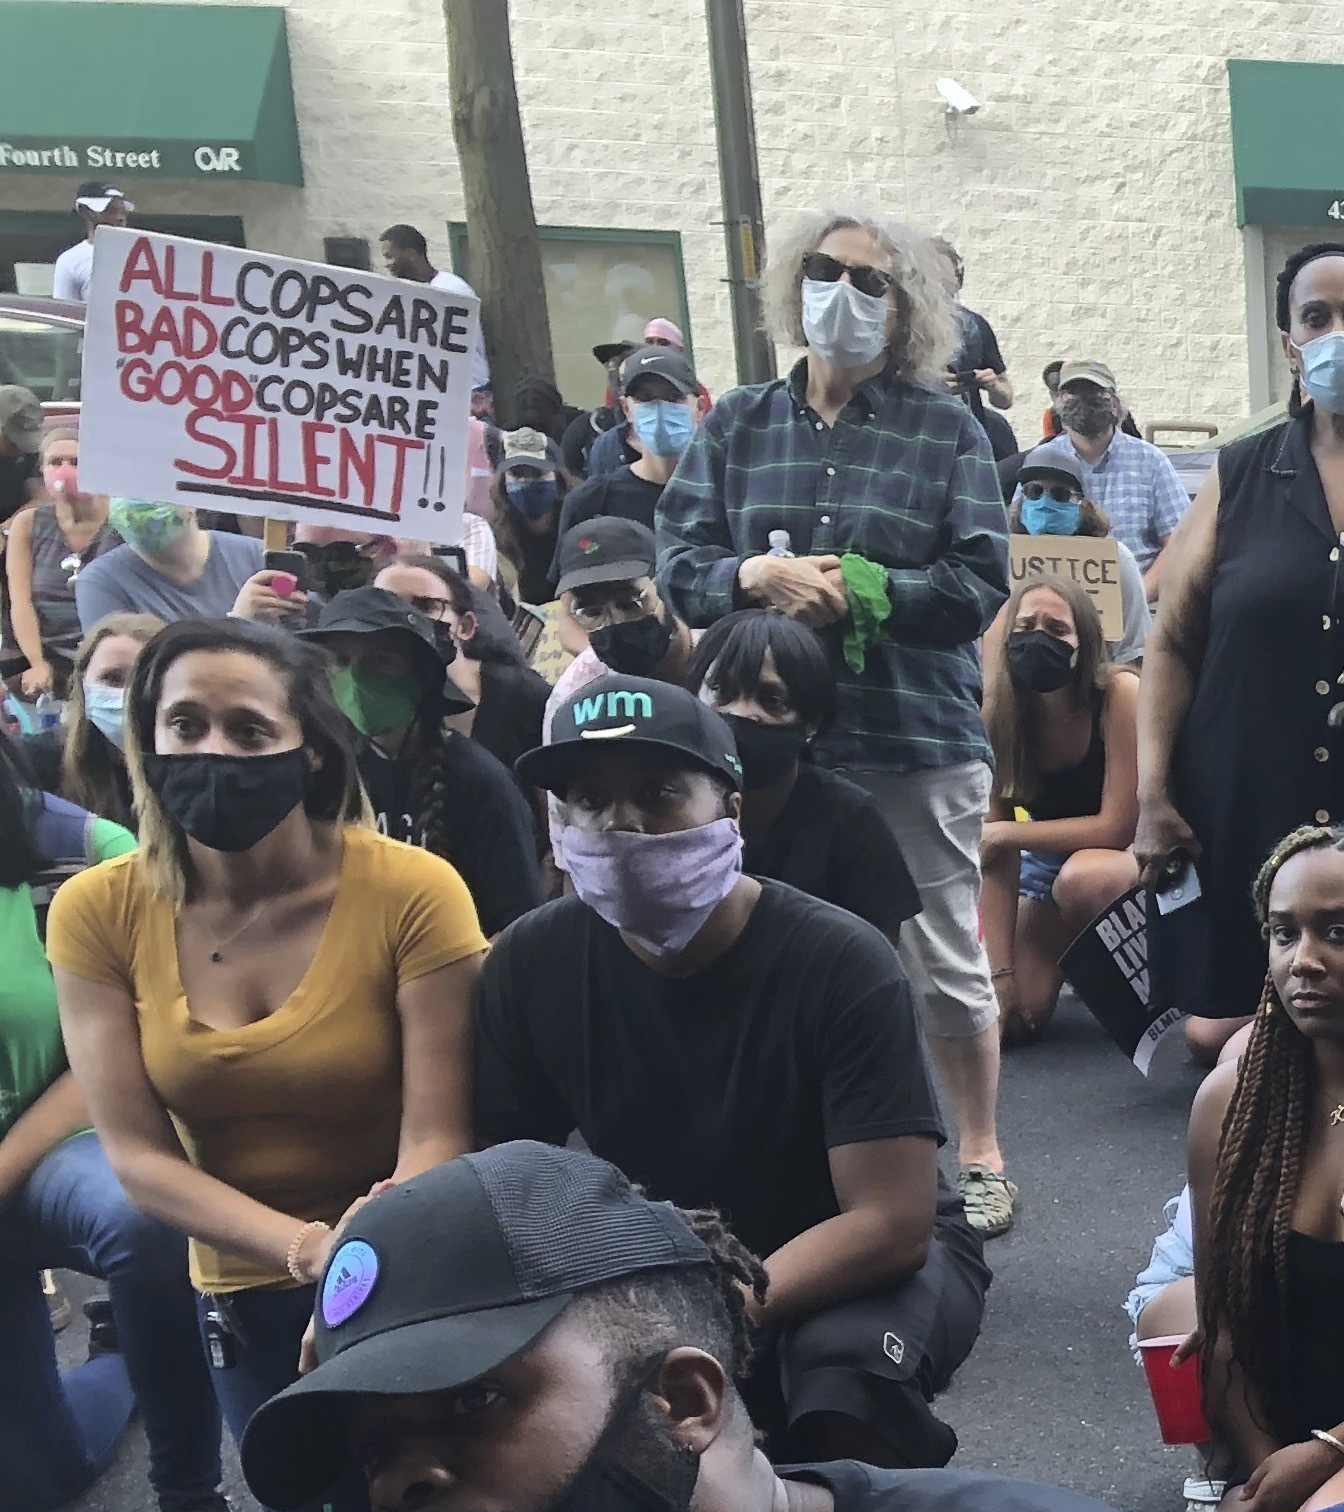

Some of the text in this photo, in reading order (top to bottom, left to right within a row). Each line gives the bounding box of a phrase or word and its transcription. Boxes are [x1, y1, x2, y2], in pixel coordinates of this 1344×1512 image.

[0, 142, 160, 169] Fourth Street
[118, 236, 470, 354] ALL COPS ARE
[114, 299, 449, 394] BAD COPS WHEN
[255, 374, 363, 423] COPS
[361, 393, 439, 440] ARE
[172, 407, 446, 514] SILENT!!
[1010, 556, 1118, 585] USTICE
[572, 690, 653, 726] wm
